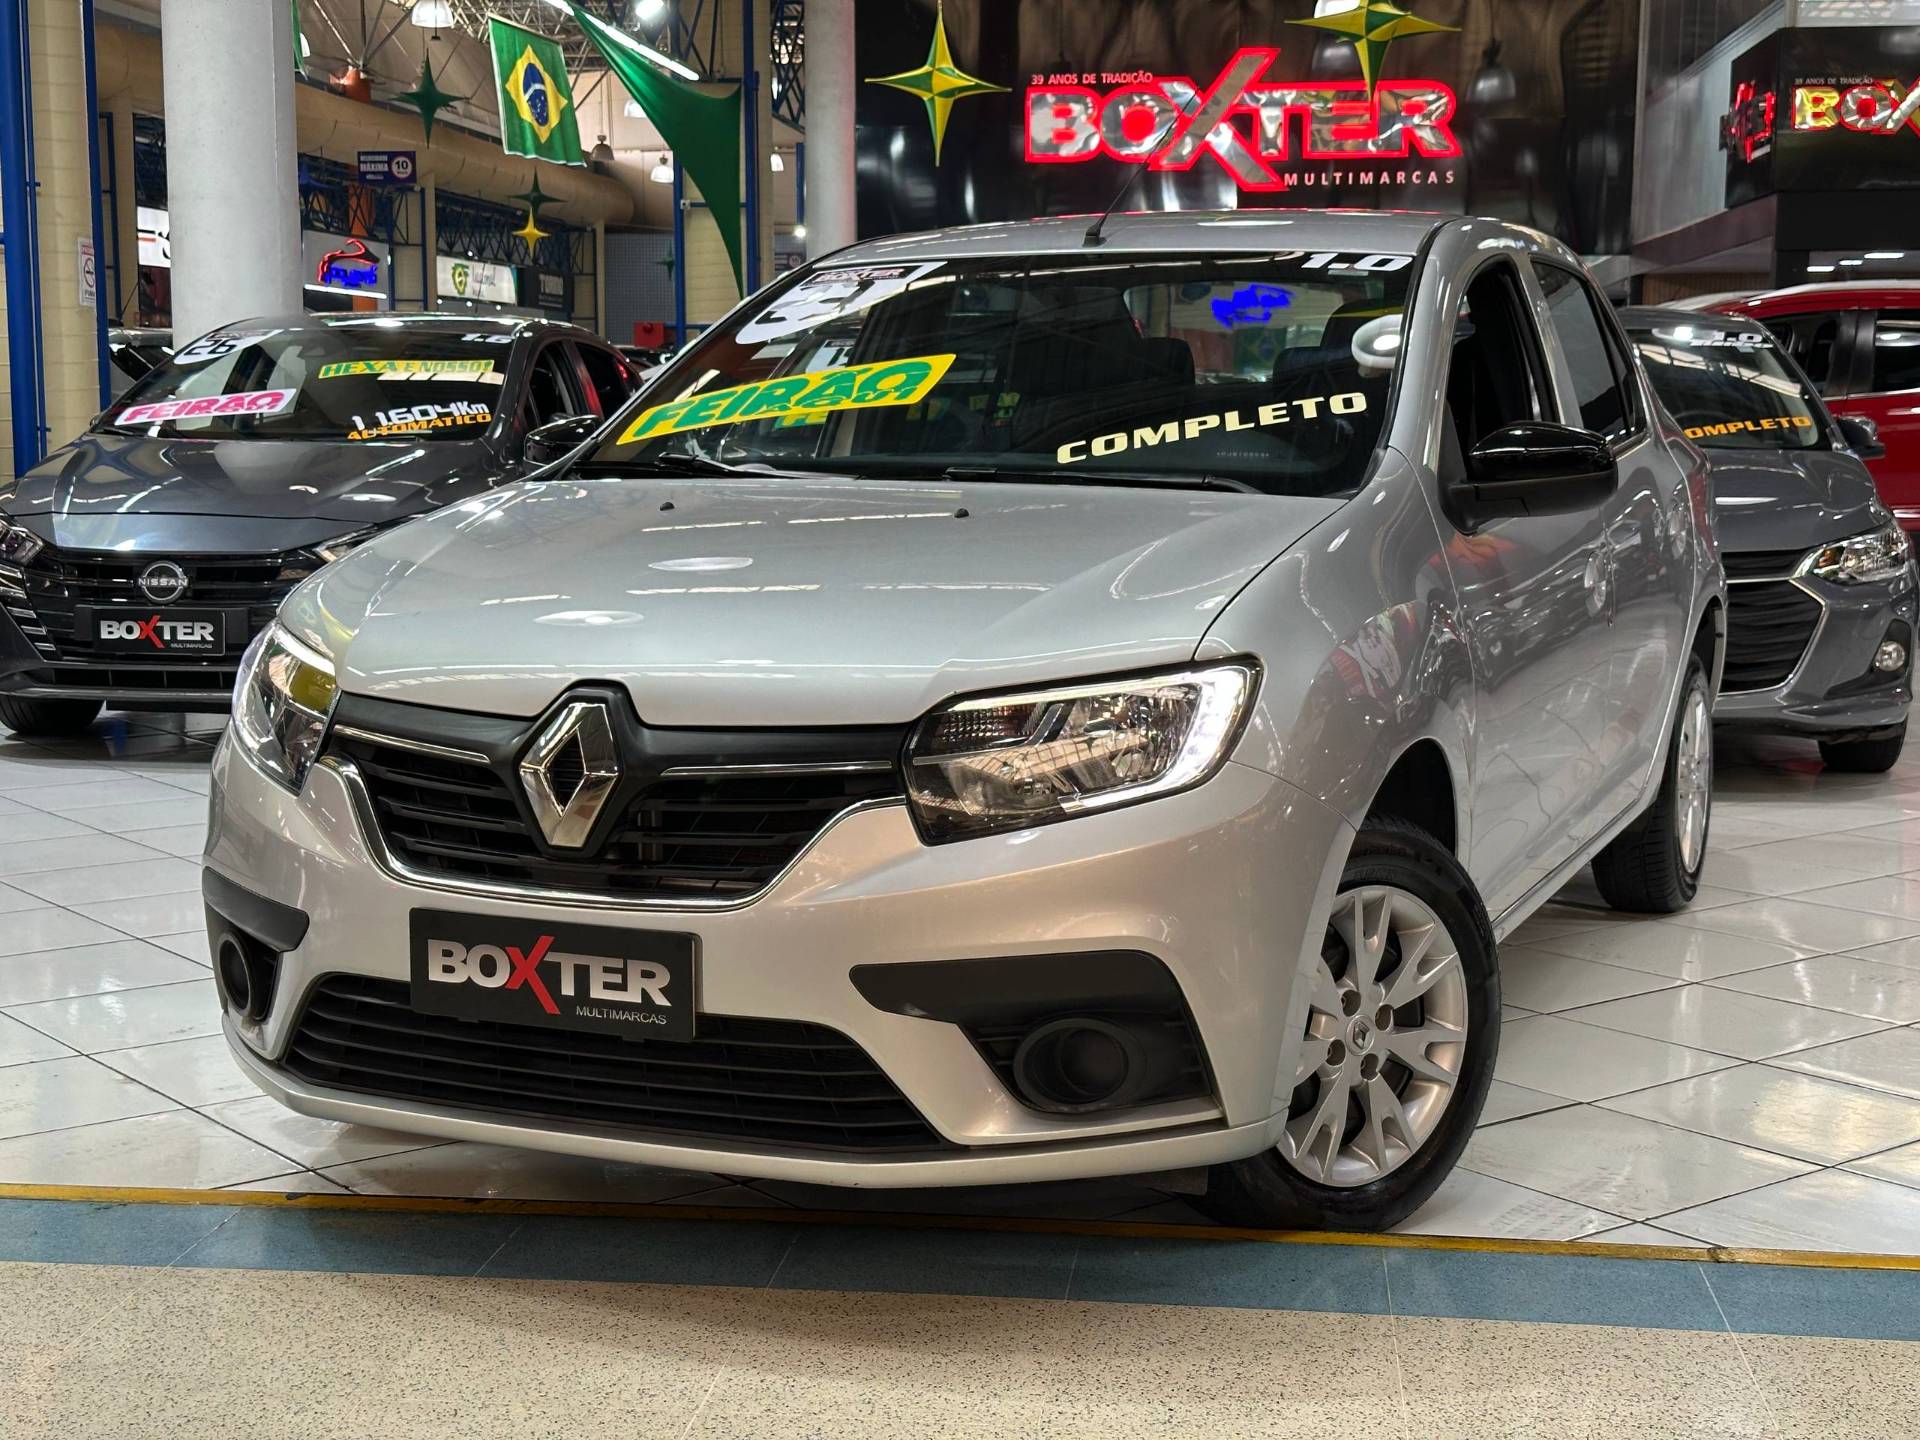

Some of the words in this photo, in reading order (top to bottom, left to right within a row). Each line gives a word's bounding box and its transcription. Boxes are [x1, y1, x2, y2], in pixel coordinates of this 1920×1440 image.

[1031, 74, 1044, 84] 39
[1048, 74, 1078, 84] ANOS
[1082, 73, 1096, 83] DE
[1101, 70, 1153, 83] TRADIÇÃO
[1025, 48, 1463, 191] BOXTER
[395, 160, 408, 170] 10
[1284, 170, 1456, 187] MULTIMARCAS
[1301, 253, 1413, 272] 1.0
[323, 361, 397, 376] HEXA
[1057, 392, 1367, 464] COMPLETO
[1683, 416, 1812, 439] OMPLETO
[138, 577, 188, 586] NISSAN
[100, 614, 215, 648] BOXTER
[427, 935, 673, 1015] BOXTER
[576, 1004, 667, 1026] MULTIMARCAS
